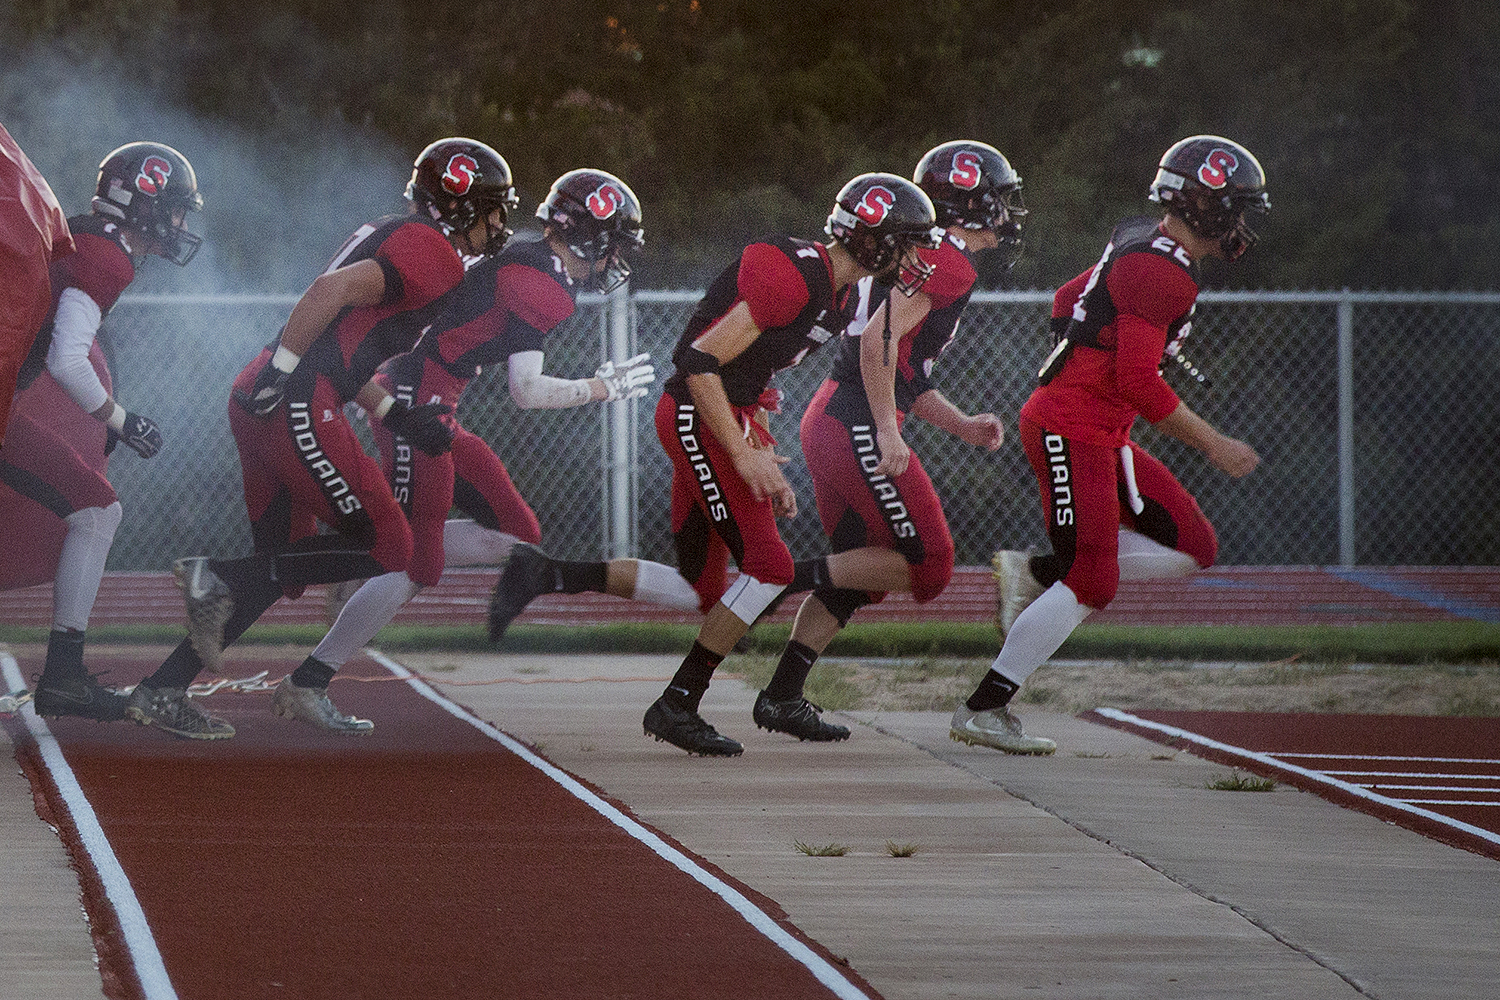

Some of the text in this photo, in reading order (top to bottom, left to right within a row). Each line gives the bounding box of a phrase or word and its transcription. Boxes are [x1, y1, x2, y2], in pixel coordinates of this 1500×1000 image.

[135, 155, 172, 197] S
[441, 153, 480, 196] S
[949, 149, 984, 191] S
[1198, 148, 1239, 190] S
[586, 183, 626, 220] S
[854, 185, 896, 228] S
[290, 402, 362, 515] INDIANS
[396, 385, 414, 504] INANS
[677, 404, 729, 523] INDIANS
[852, 425, 916, 538] INDIANS
